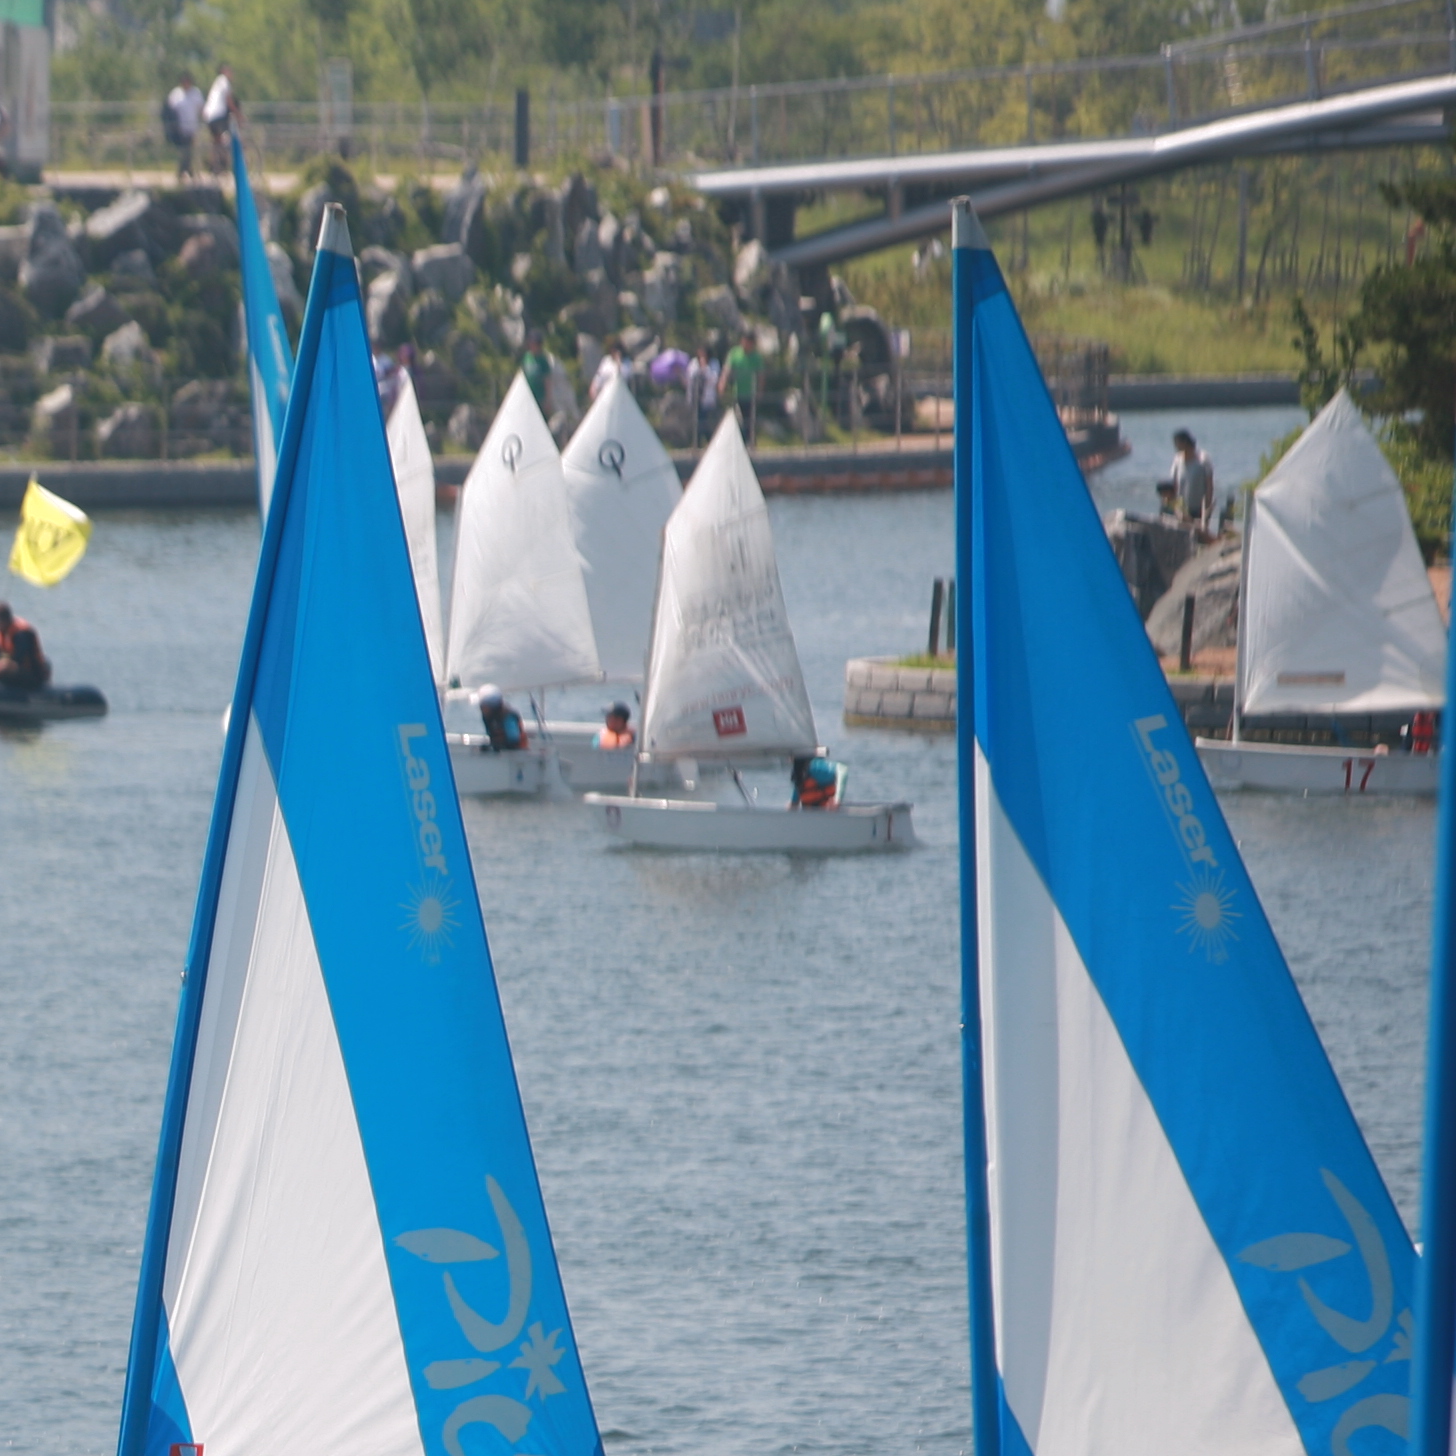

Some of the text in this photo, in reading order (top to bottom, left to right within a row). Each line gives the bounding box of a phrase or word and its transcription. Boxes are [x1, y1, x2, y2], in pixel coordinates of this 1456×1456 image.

[398, 713, 450, 876] Laser
[1135, 713, 1220, 868] Laser
[1341, 757, 1376, 792] 17
